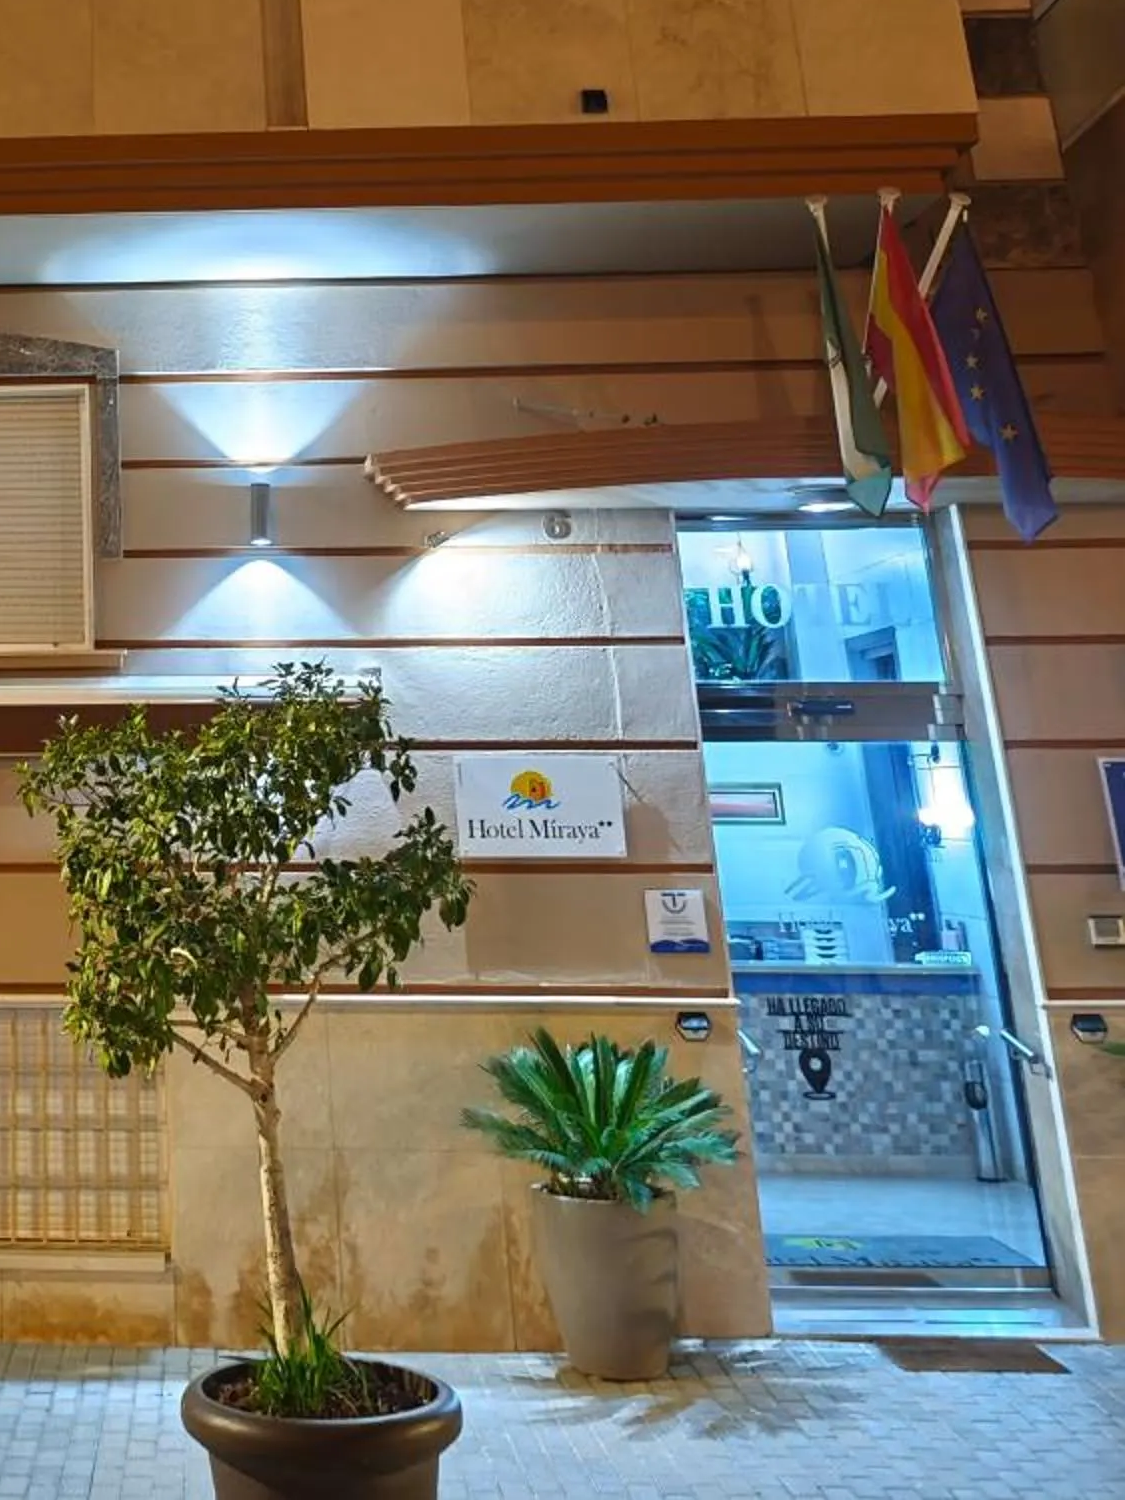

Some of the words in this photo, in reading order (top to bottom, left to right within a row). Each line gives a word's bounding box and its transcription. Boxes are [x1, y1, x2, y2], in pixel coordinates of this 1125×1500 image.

[541, 510, 572, 540] 6
[706, 581, 912, 629] HOTEL
[468, 819, 524, 839] Hotel
